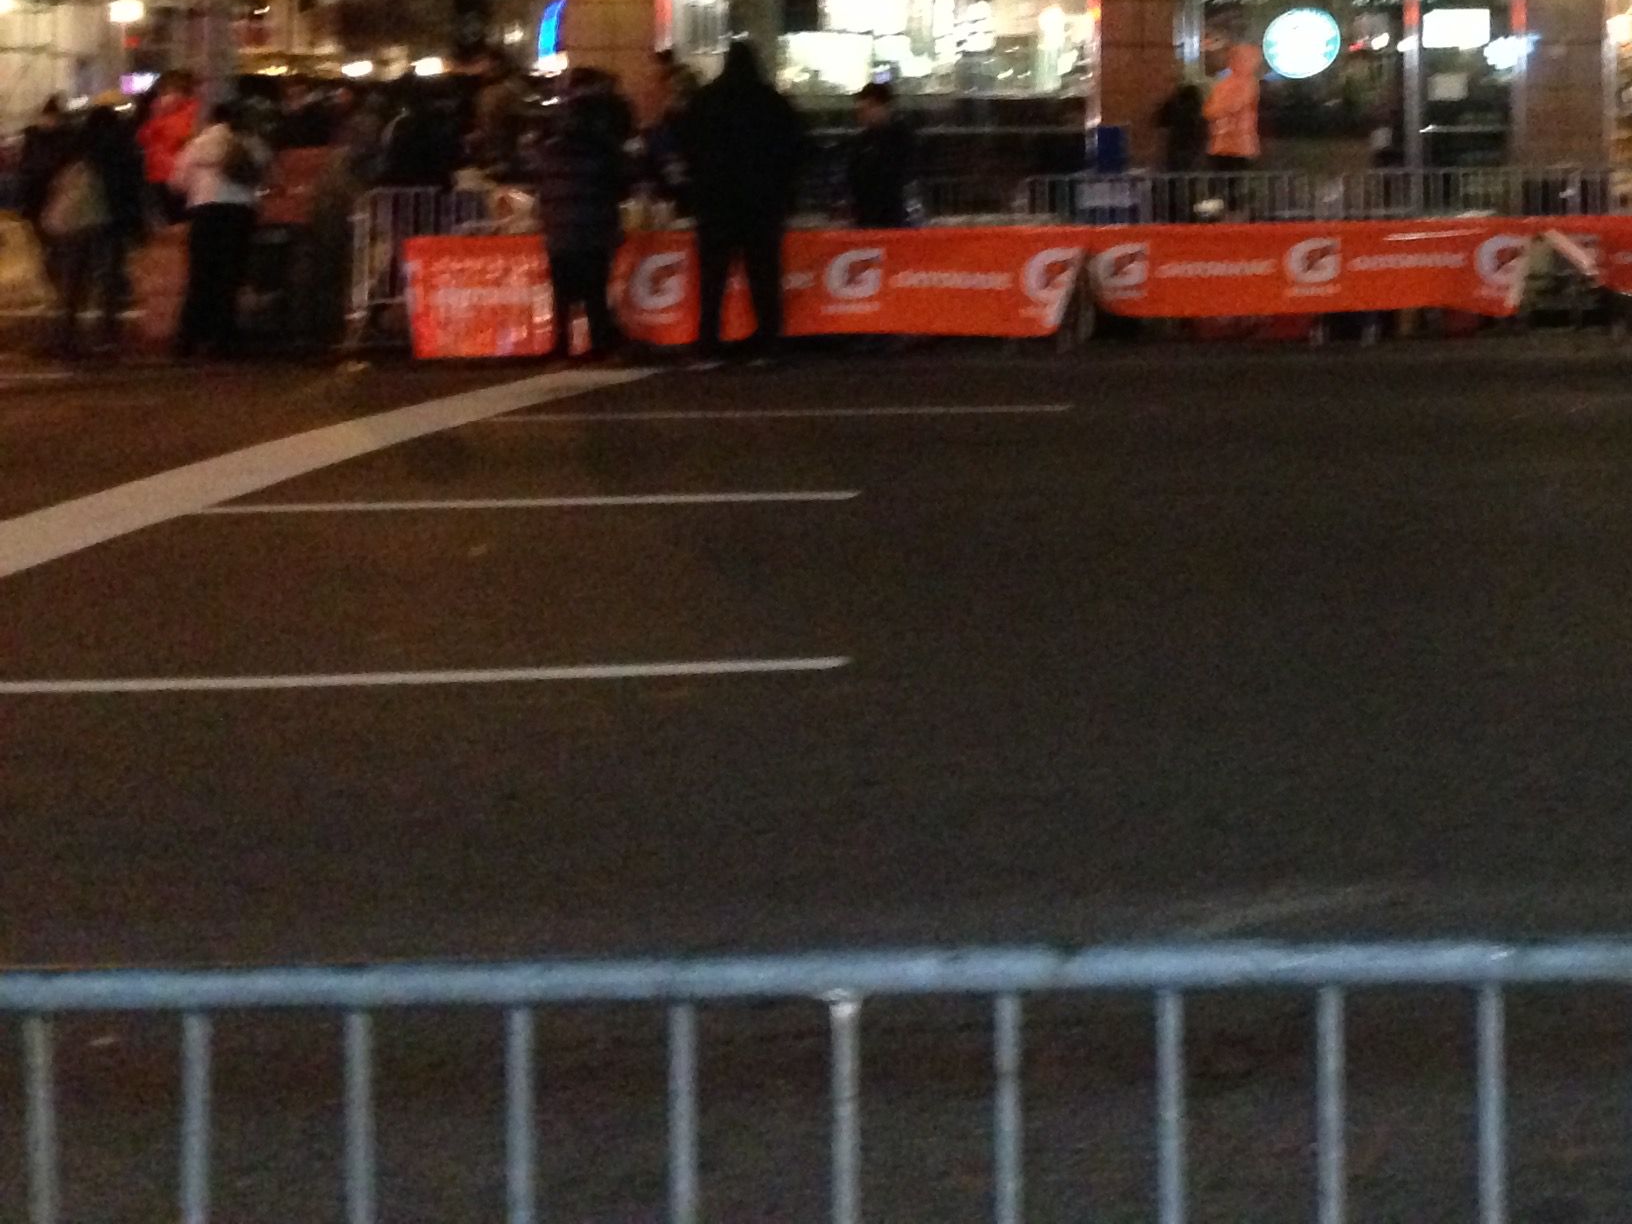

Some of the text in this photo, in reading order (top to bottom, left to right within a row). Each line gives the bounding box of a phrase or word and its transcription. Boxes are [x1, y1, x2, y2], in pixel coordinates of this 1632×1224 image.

[630, 251, 689, 309] G
[825, 247, 884, 299] G
[1286, 237, 1341, 285] G
